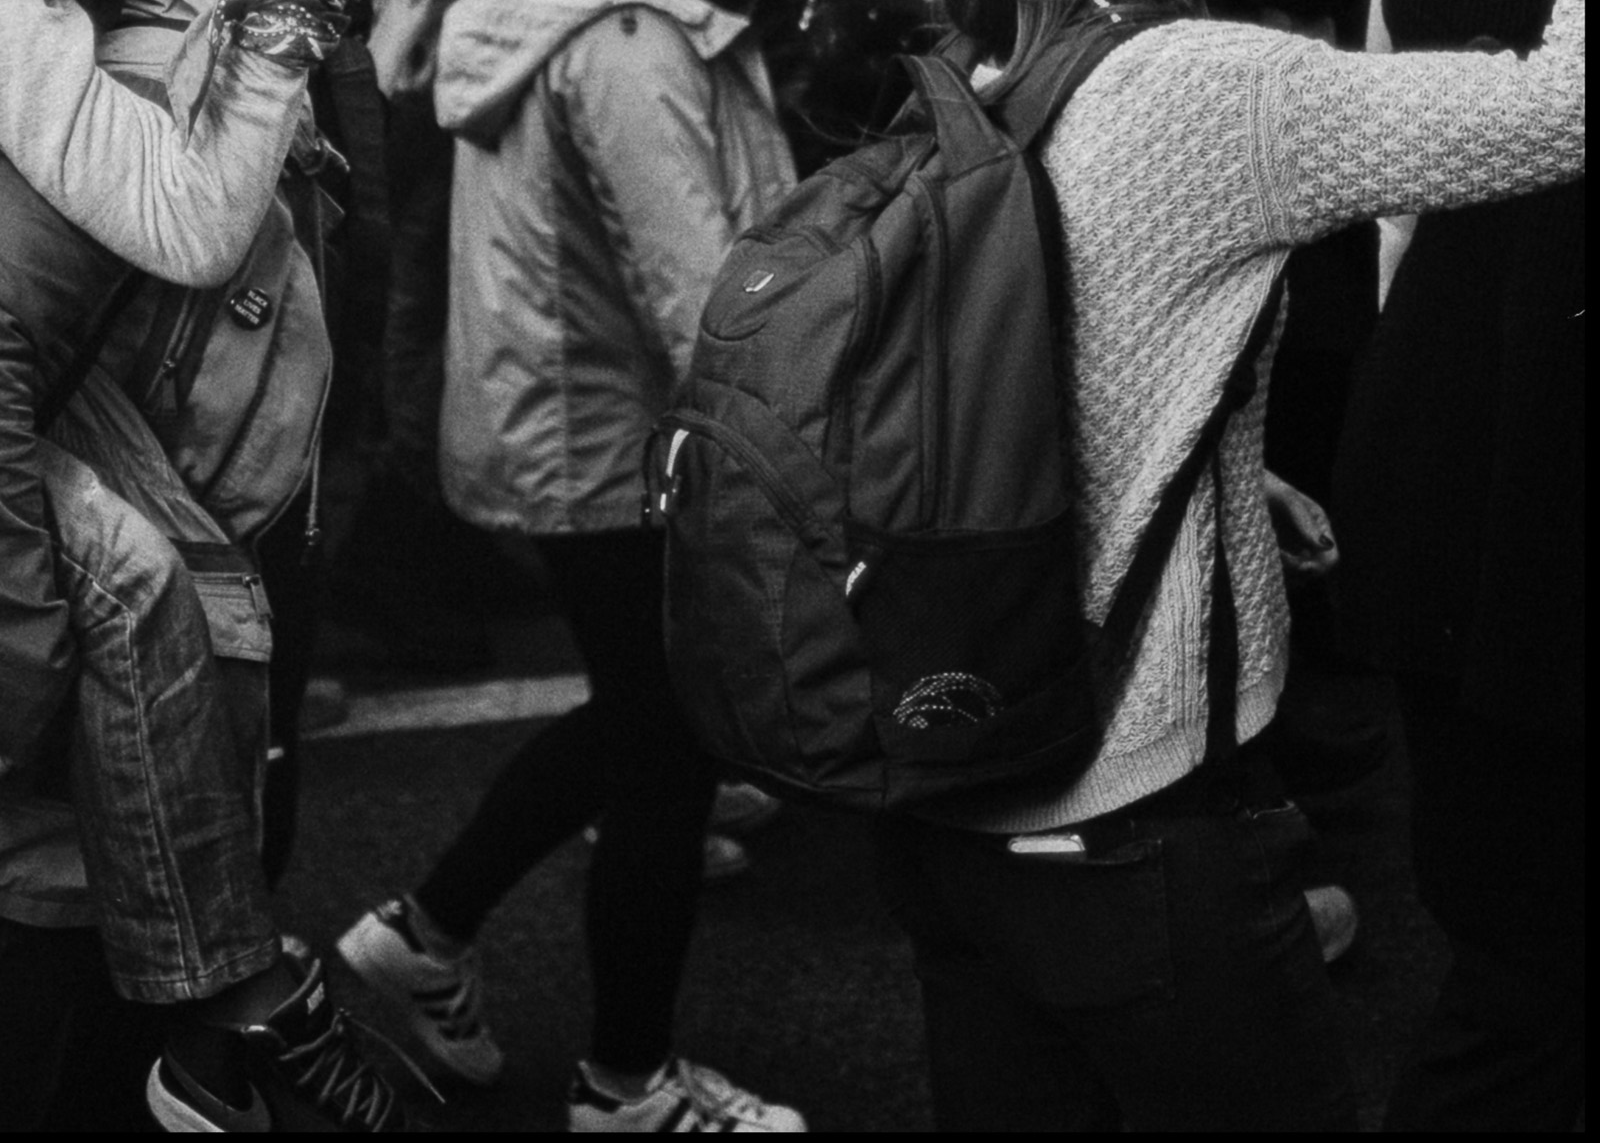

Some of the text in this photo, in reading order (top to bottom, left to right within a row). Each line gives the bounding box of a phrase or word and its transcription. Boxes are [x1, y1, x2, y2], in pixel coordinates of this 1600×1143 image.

[243, 299, 262, 315] LIVES
[247, 289, 268, 307] BLACK
[235, 304, 261, 325] MATTER
